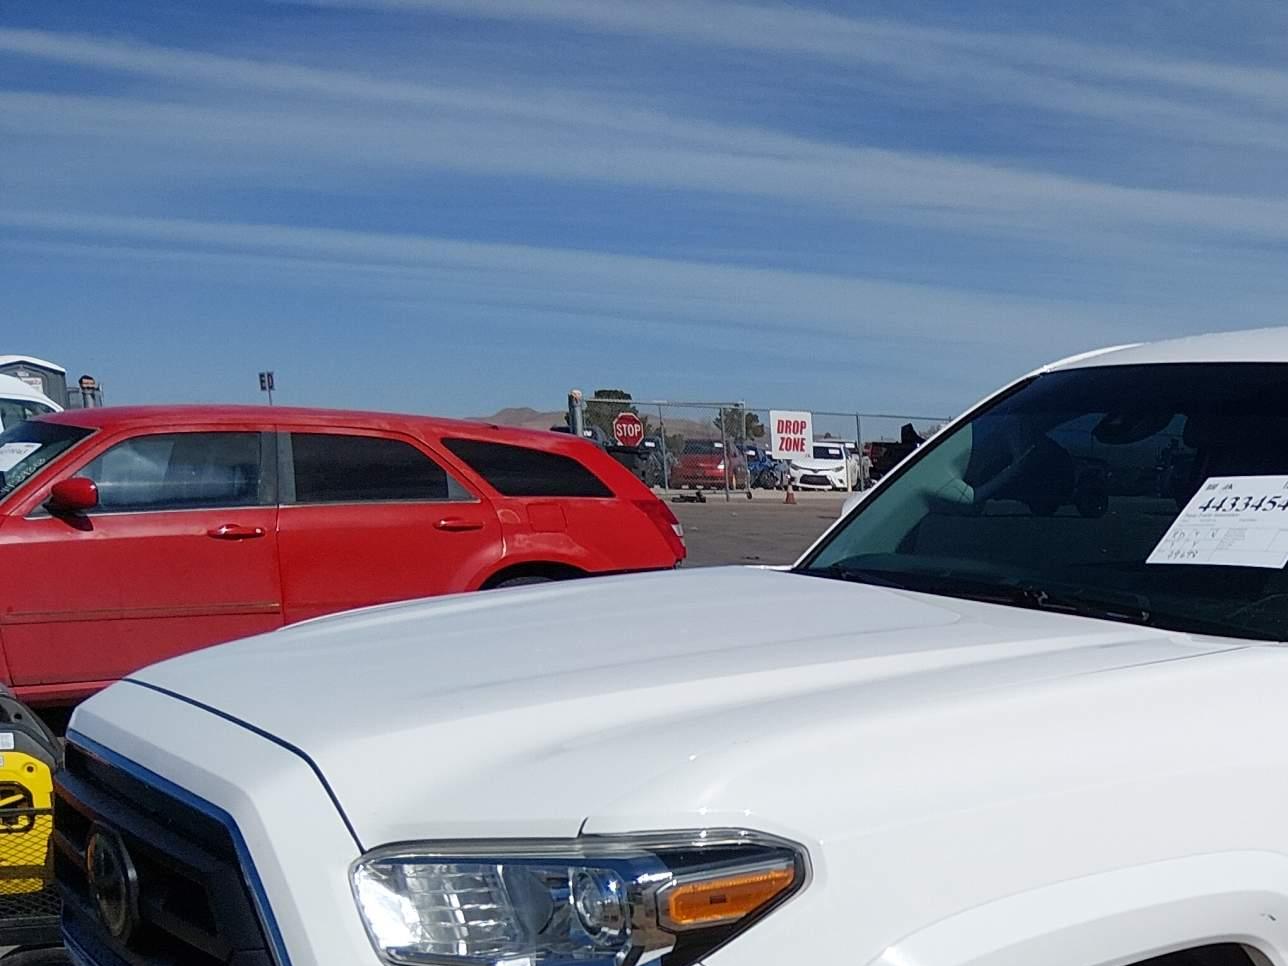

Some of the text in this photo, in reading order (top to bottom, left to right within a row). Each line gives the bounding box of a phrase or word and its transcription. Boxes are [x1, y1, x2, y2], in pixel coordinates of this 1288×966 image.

[616, 423, 641, 437] STOP
[776, 419, 806, 435] DROP
[779, 436, 806, 452] ZONE
